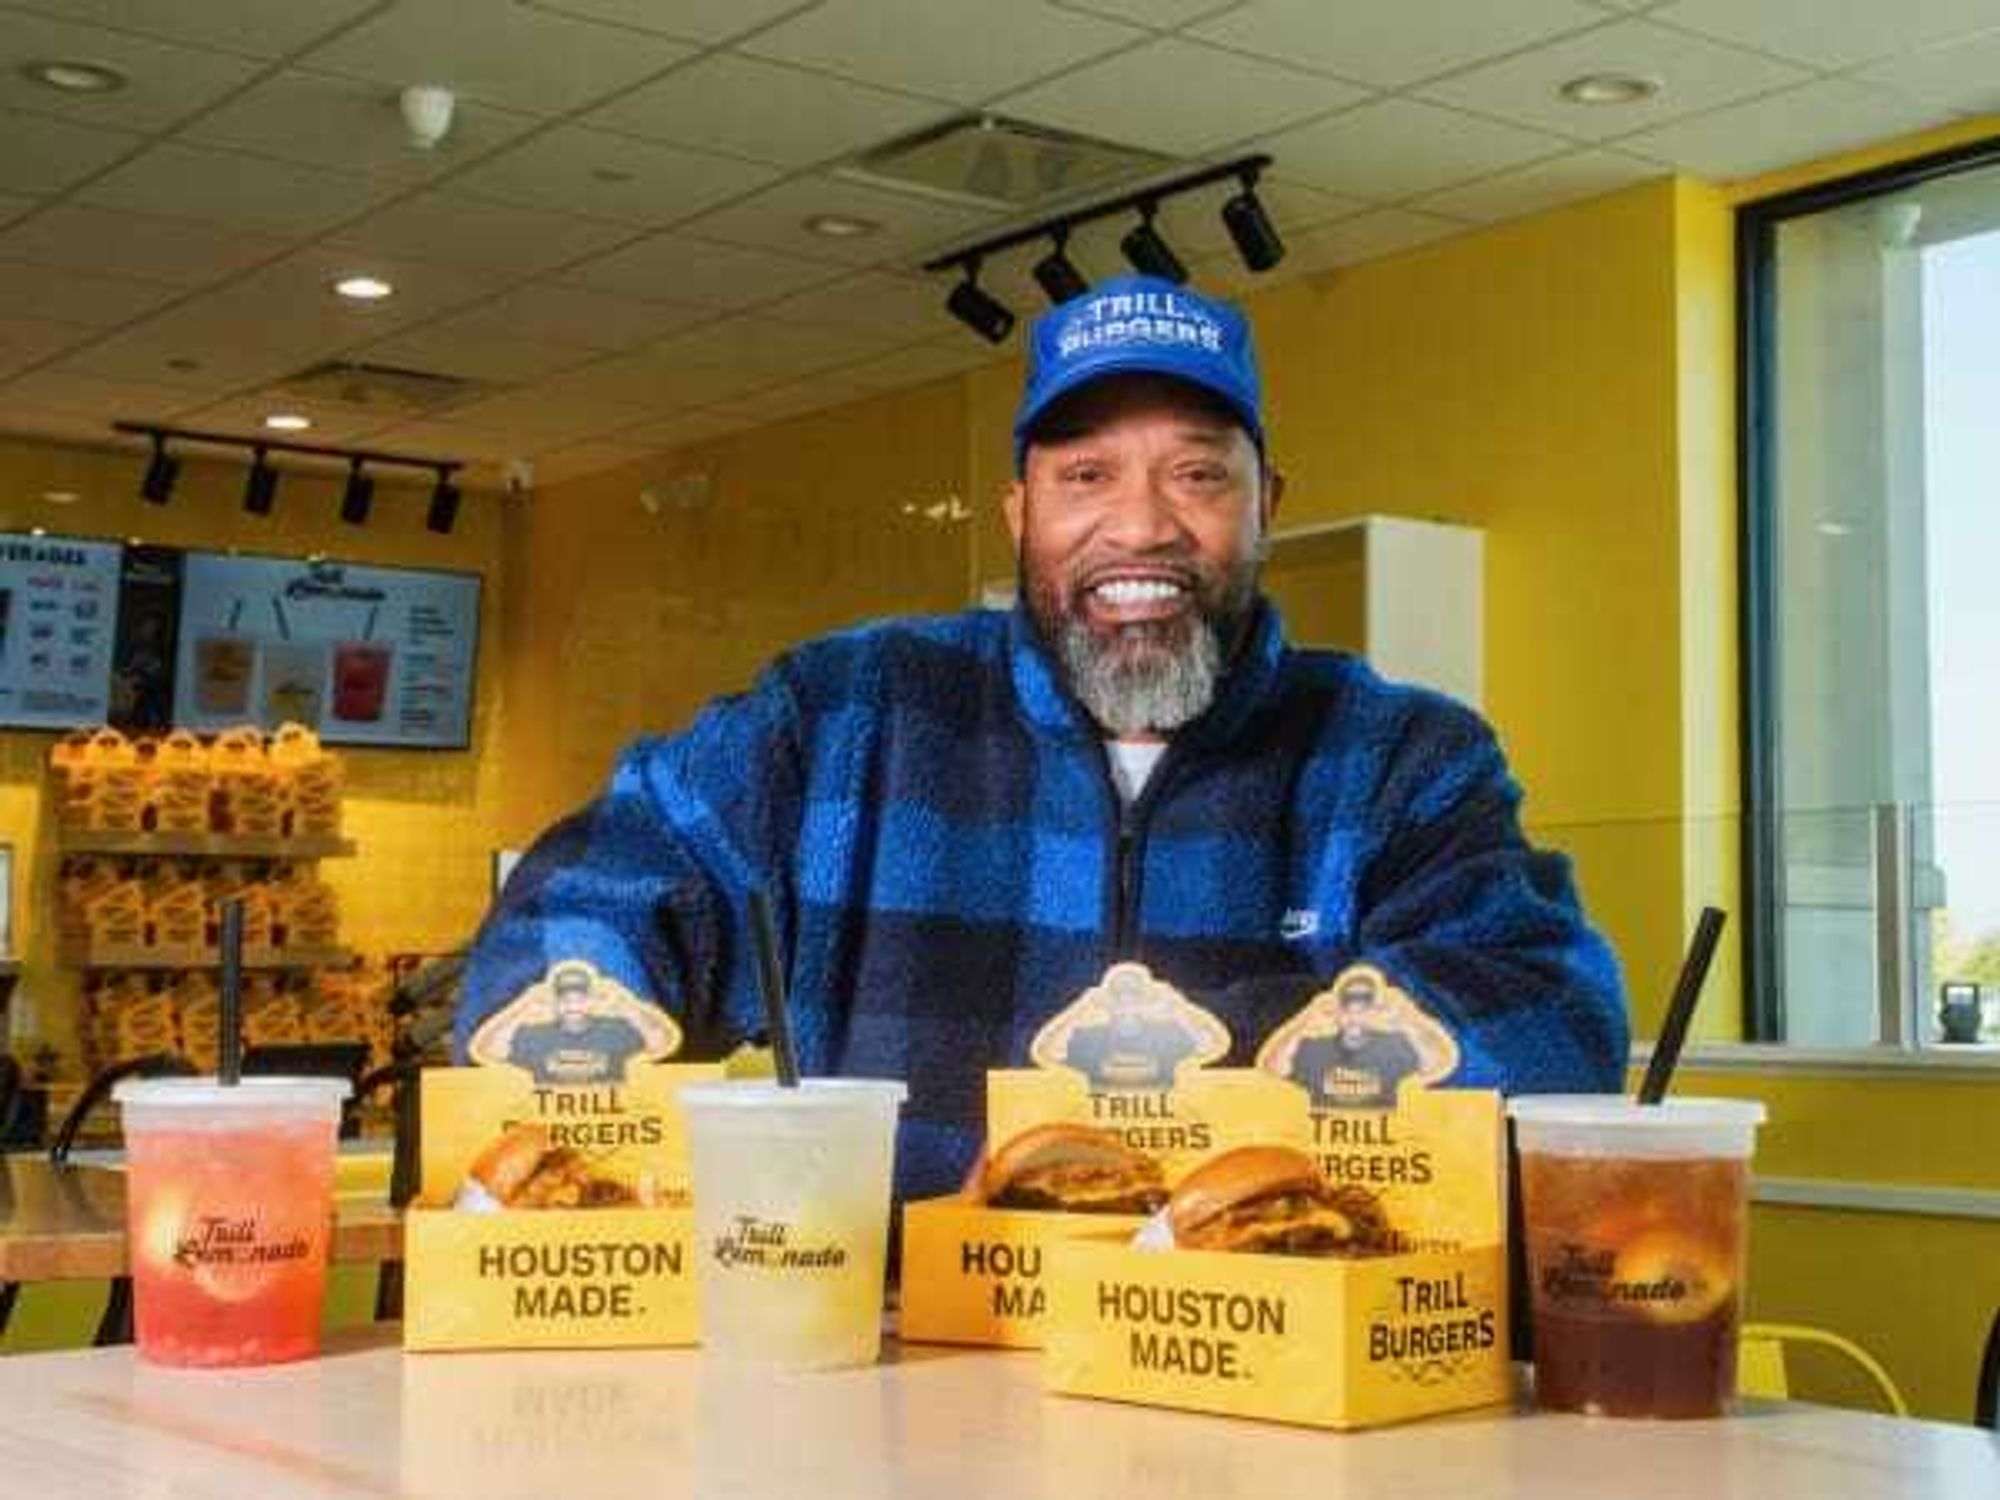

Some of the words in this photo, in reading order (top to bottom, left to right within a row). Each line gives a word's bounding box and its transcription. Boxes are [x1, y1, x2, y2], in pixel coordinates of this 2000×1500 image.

[1088, 293, 1185, 321] TRILL
[534, 1087, 625, 1116] TRILL
[1088, 1093, 1174, 1118] TRILL
[503, 1116, 663, 1146] RGERS
[1125, 1122, 1212, 1149] GERS
[1308, 1113, 1397, 1146] TRILL
[1315, 1152, 1433, 1184] RGERS
[479, 1242, 683, 1278] HOUSTON
[1097, 1280, 1286, 1336] HOUSTON
[1395, 1271, 1469, 1315] TRILL
[1369, 1310, 1496, 1361] BURGERS
